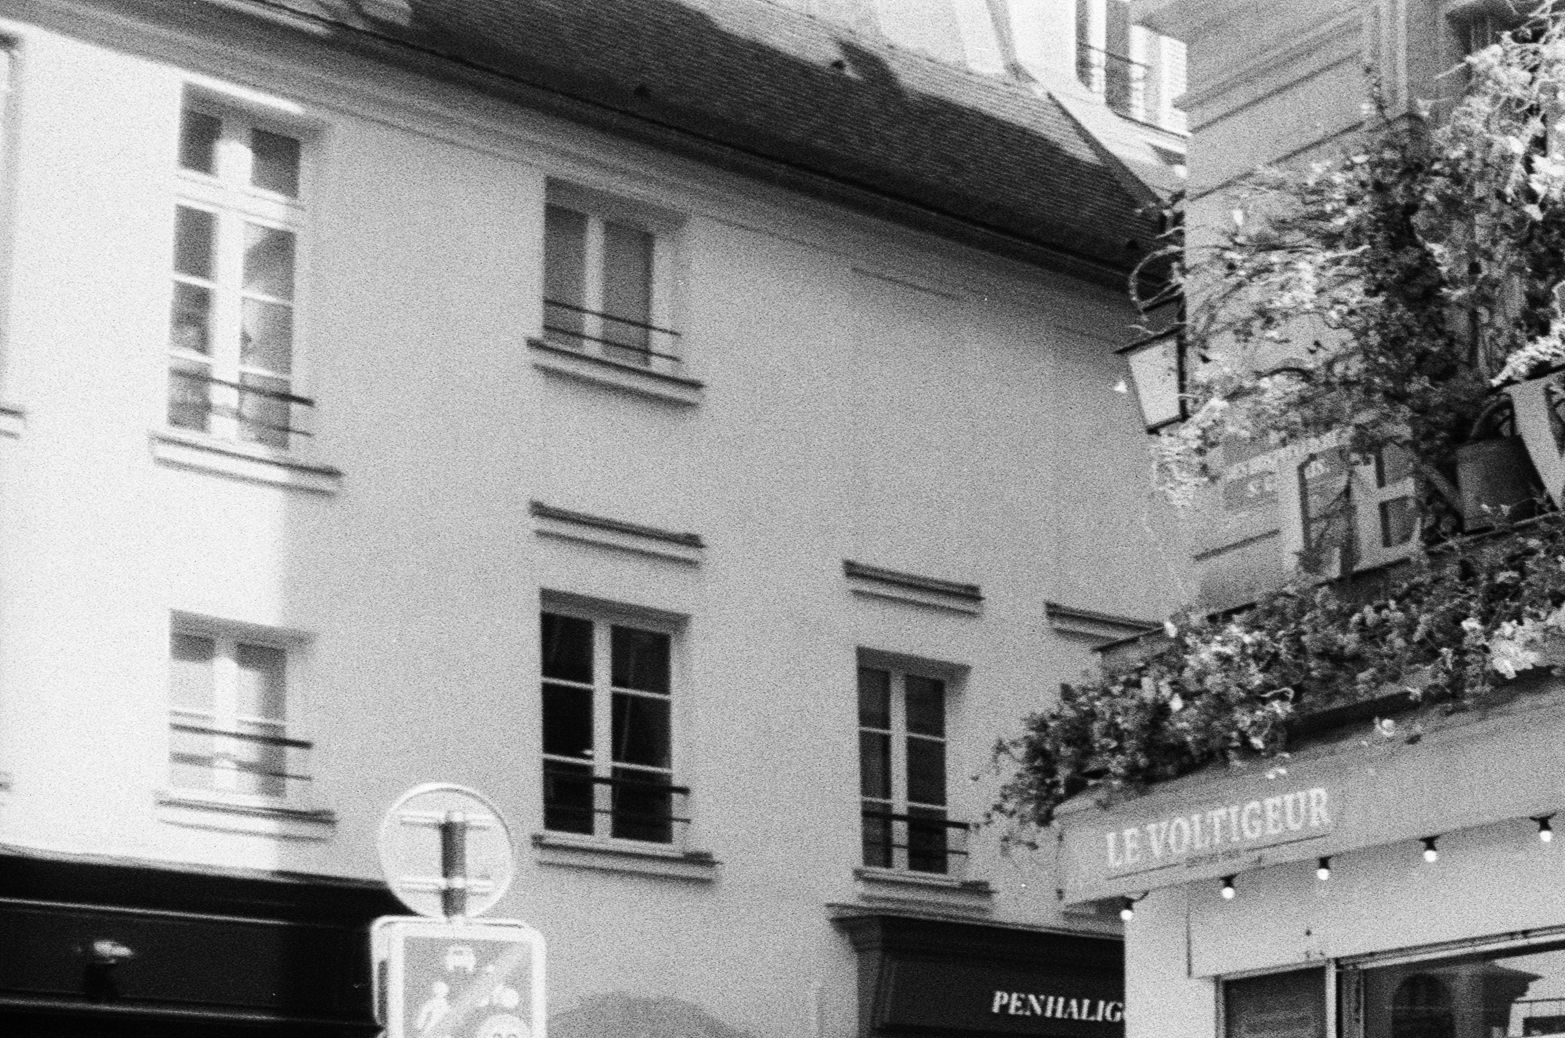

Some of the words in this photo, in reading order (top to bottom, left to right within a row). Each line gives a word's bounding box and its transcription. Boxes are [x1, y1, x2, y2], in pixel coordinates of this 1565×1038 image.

[1105, 827, 1141, 867] LE
[1145, 787, 1332, 861] VOLTIGEUR
[991, 989, 1124, 1023] PENHALIG
